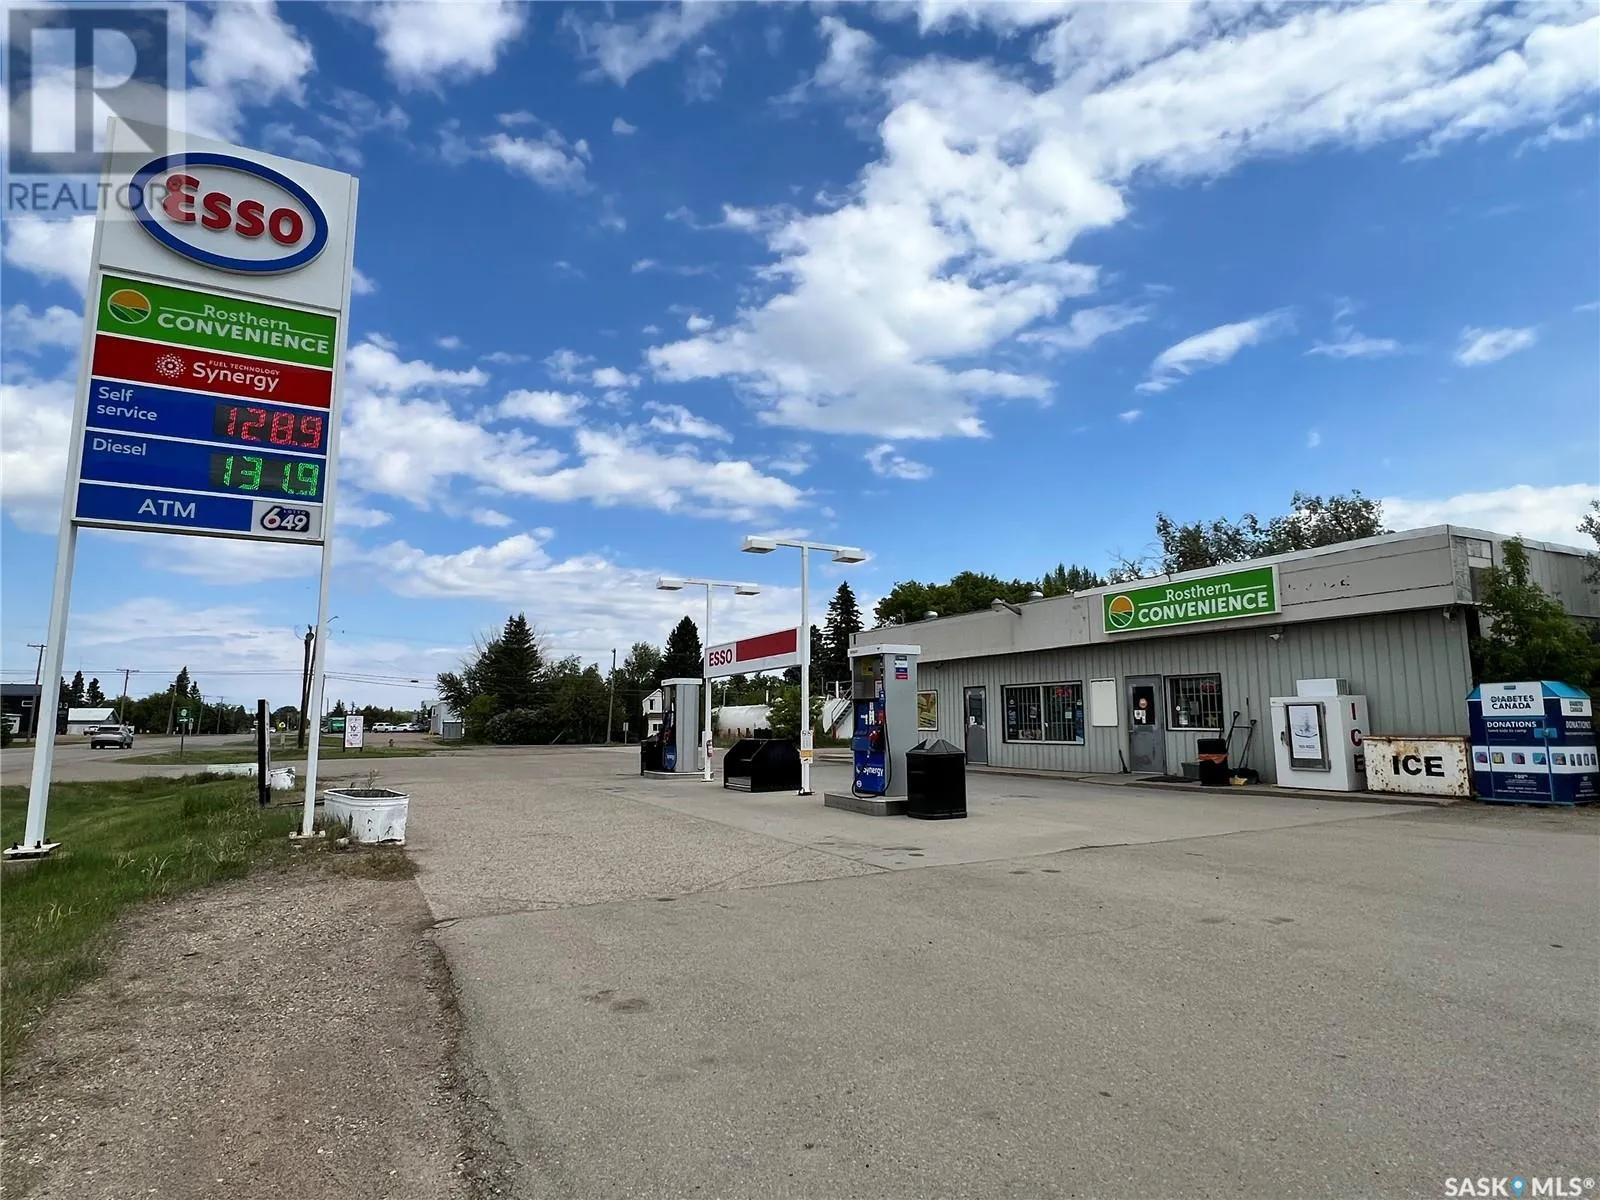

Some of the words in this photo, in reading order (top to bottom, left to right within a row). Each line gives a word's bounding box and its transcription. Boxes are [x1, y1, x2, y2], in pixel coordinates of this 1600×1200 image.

[204, 304, 290, 331] Rosthern
[157, 312, 330, 355] CONVENIENCE
[192, 361, 280, 392] Synergy
[209, 360, 228, 368] FUEL
[230, 363, 280, 376] TECHNOLOGY
[98, 386, 134, 402] Self
[96, 404, 158, 421] service
[92, 437, 147, 456] Diesel
[138, 498, 197, 519] ATM
[1165, 582, 1232, 602] Rosthern
[1138, 591, 1269, 623] CONVENIENCE
[708, 649, 733, 667] ESSO
[1490, 695, 1535, 703] DIABETES
[1392, 755, 1445, 777] ICE
